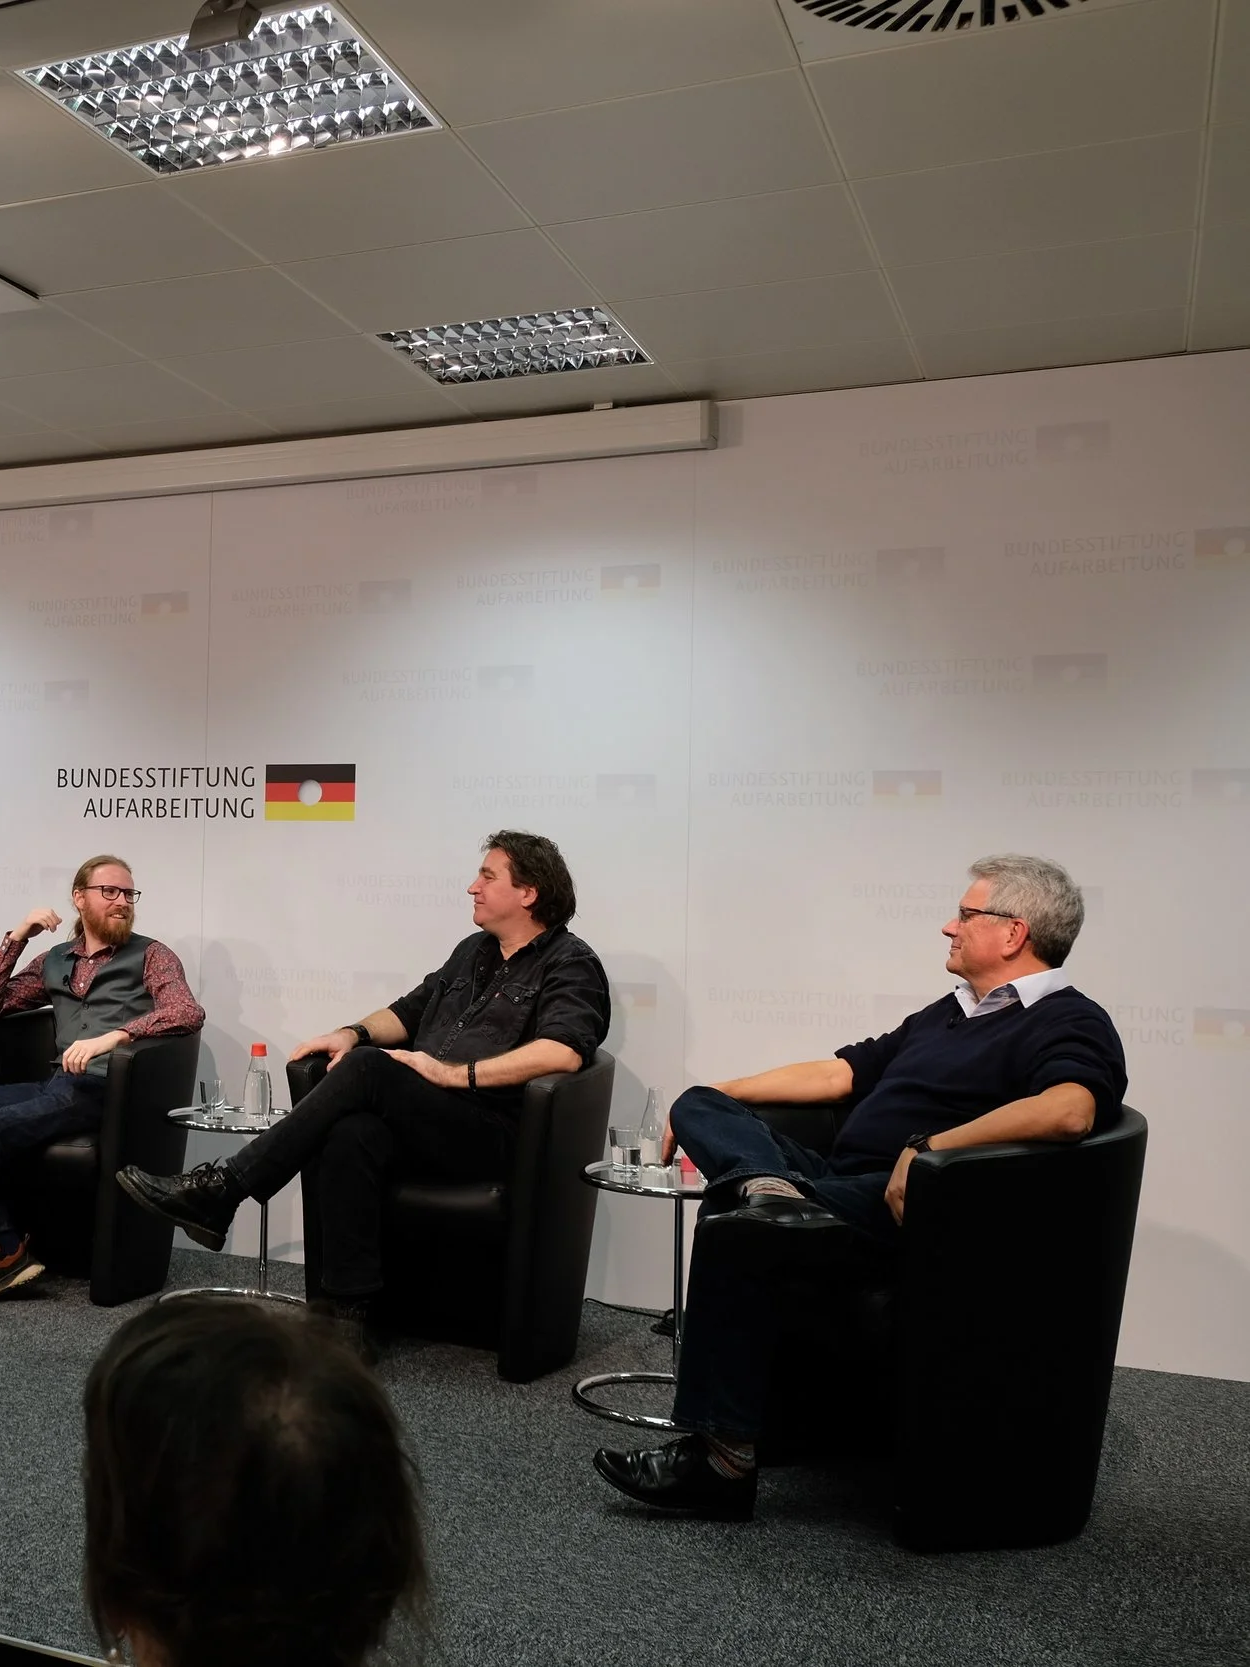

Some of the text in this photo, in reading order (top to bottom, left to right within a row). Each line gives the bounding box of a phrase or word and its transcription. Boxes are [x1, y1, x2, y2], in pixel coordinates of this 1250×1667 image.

[1003, 532, 1186, 558] BUNDESSTIFTUNG
[456, 567, 595, 589] BUNDESSTIFTUNG
[57, 766, 256, 789] BUNDESSTIFTUNG
[708, 770, 866, 787] BUNDESSTIFTUNG
[83, 797, 256, 820] AUFARBEITUNG
